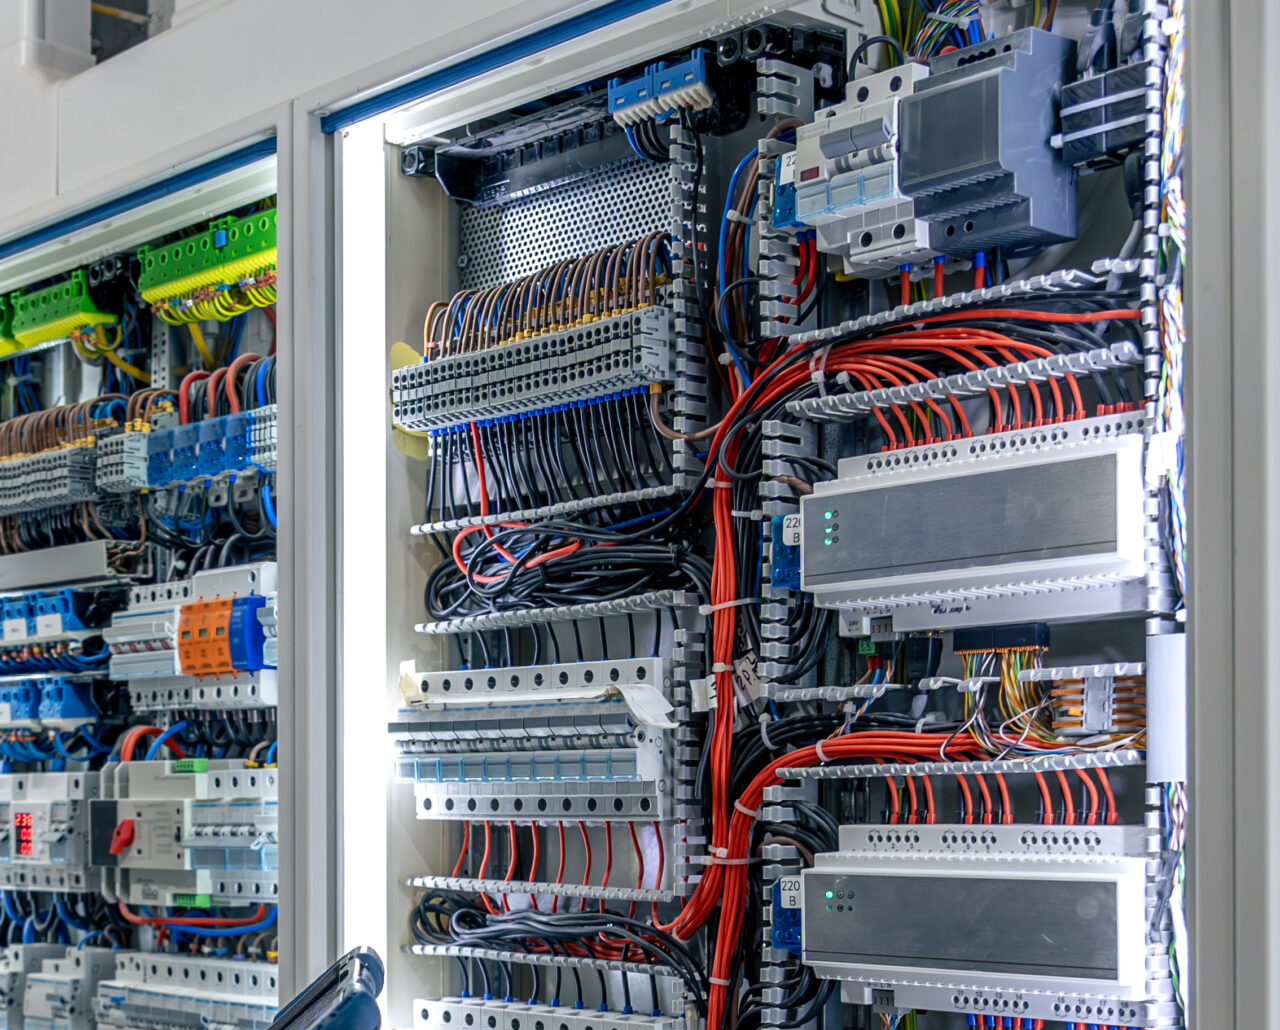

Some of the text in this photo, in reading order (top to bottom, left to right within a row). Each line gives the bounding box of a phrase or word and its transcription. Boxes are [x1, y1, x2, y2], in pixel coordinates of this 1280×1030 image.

[786, 517, 800, 528] 22
[781, 880, 801, 891] 220
[789, 896, 796, 907] B
